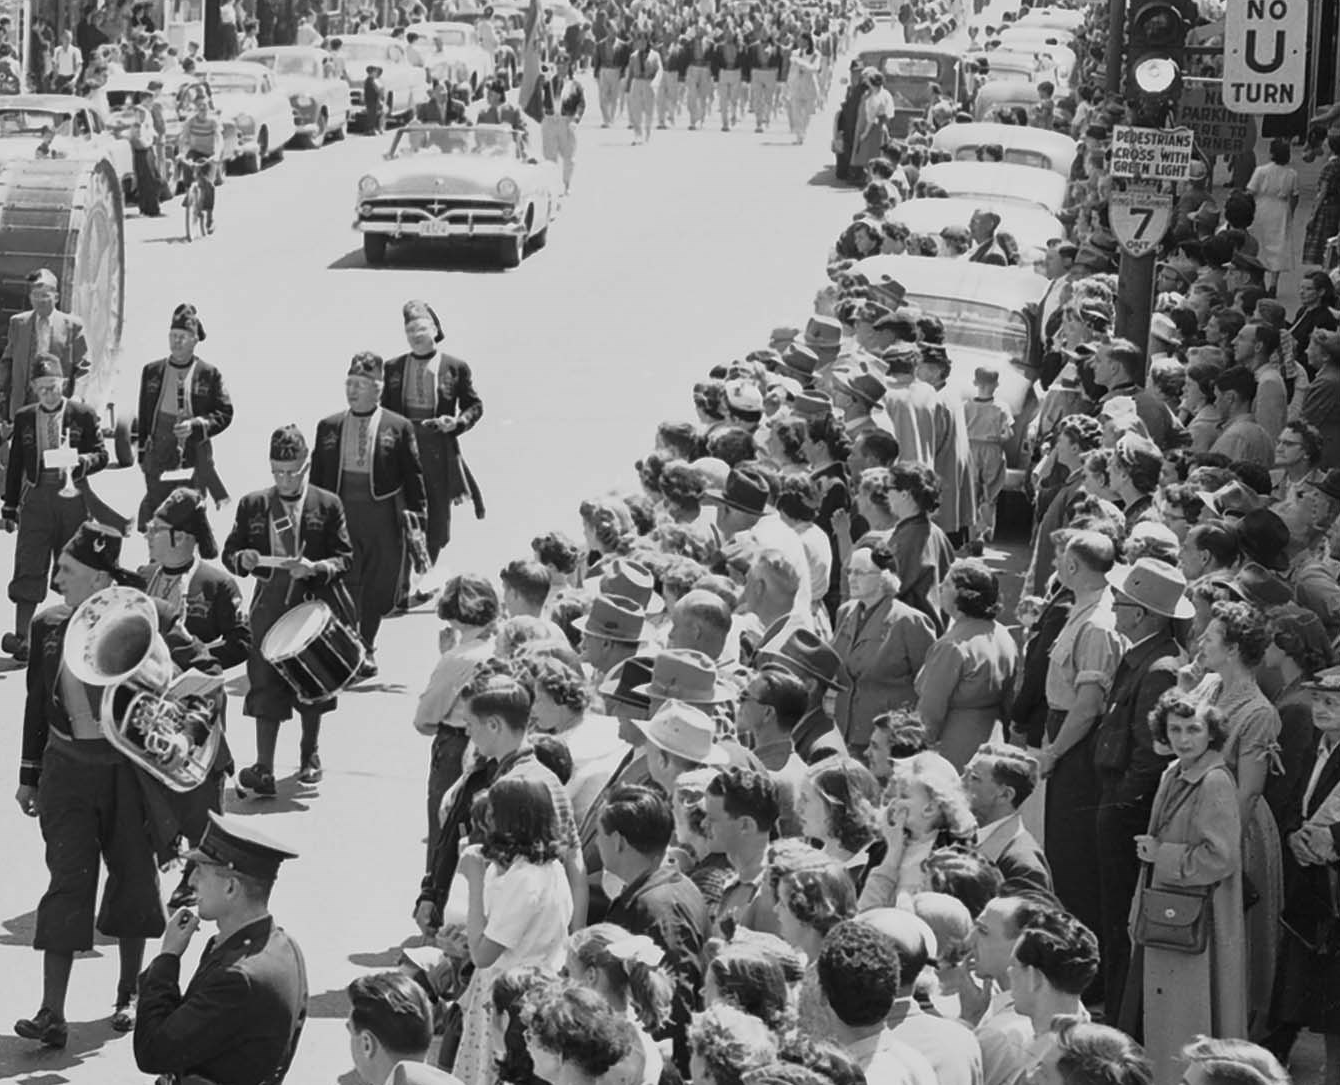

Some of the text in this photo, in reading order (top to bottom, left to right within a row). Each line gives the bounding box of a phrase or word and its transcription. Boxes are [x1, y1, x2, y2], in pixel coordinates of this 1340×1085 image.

[1244, 29, 1287, 75] U
[1230, 82, 1295, 105] TURN
[1116, 129, 1192, 149] PEDESTRIANS
[1230, 125, 1247, 139] TO
[1115, 146, 1190, 164] CROSS WITH
[1155, 163, 1188, 177] LIGHT
[1129, 208, 1155, 240] 7
